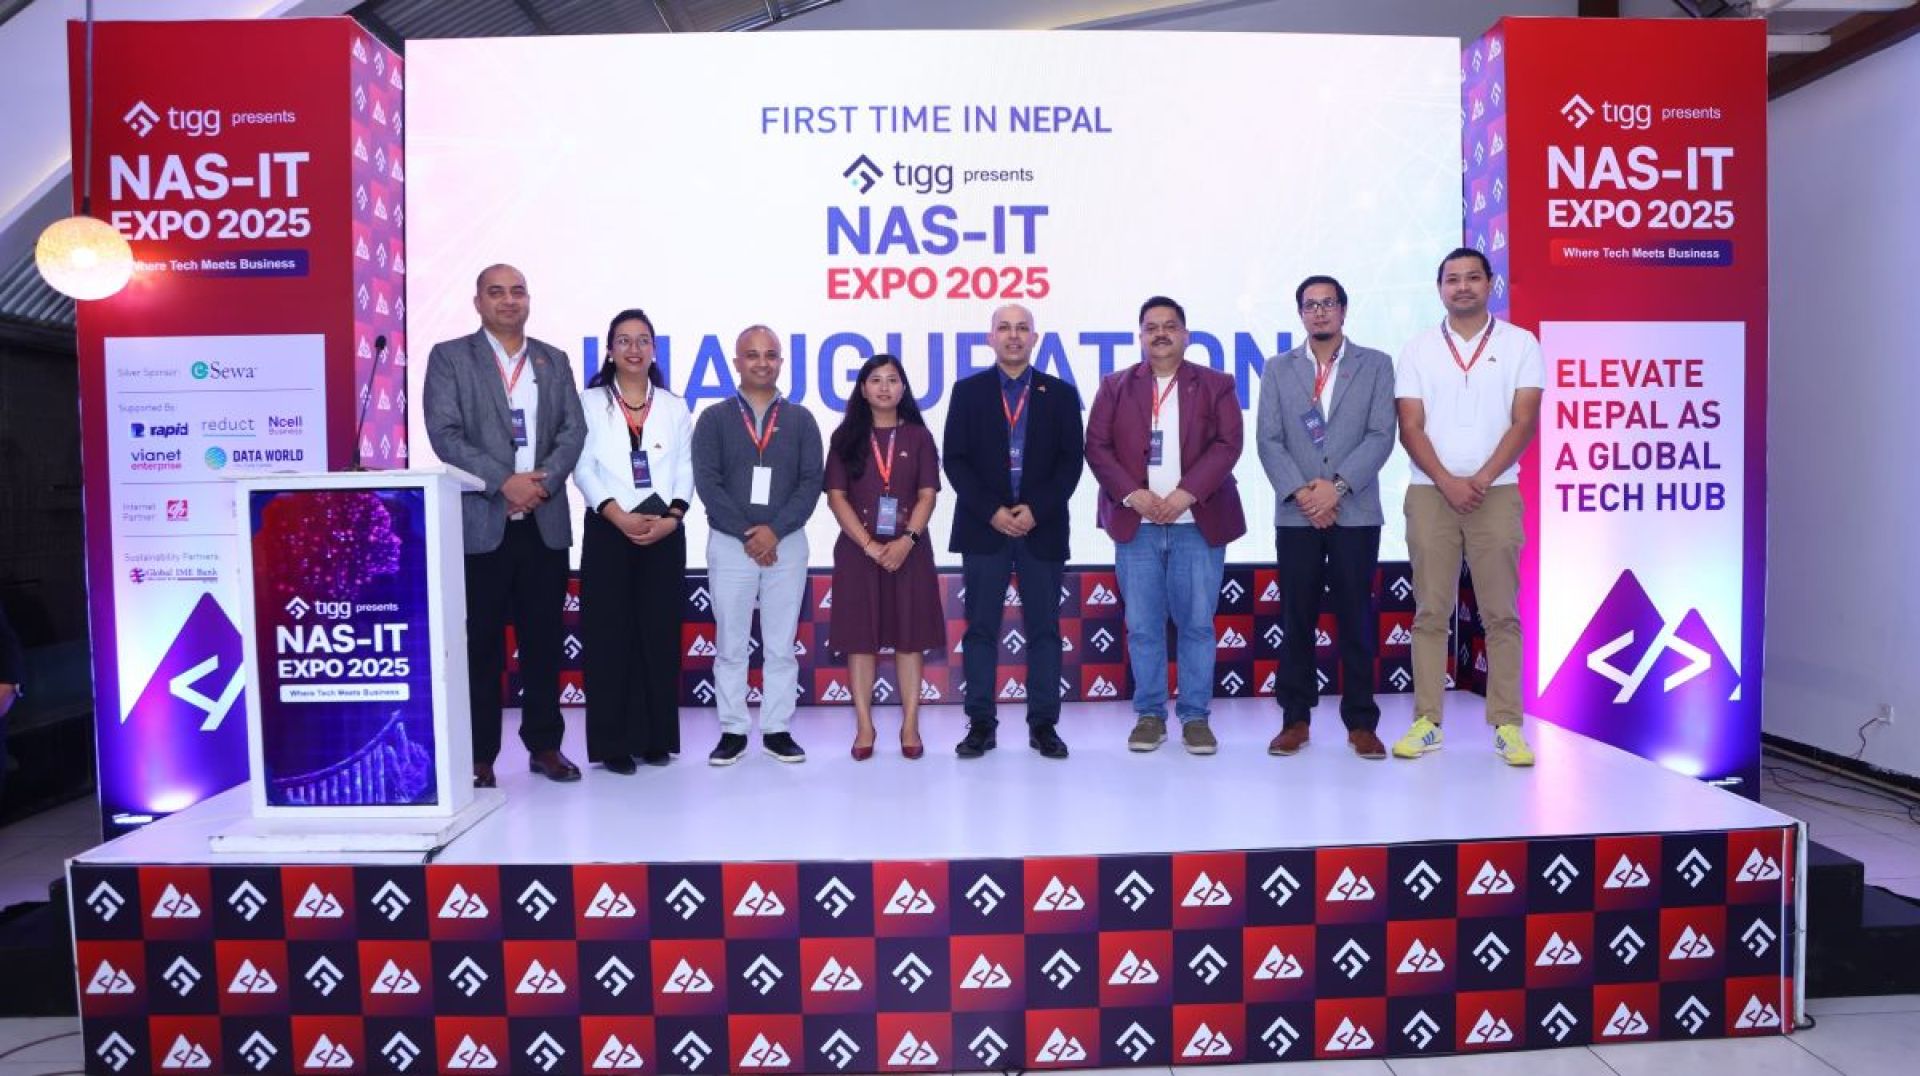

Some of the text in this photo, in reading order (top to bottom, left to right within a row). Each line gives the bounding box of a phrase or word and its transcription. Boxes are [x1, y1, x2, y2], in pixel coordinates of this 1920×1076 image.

[168, 107, 295, 137] tigg presents
[762, 105, 1113, 134] FIRST TIME IN NEPAL
[1602, 100, 1721, 130] tigg presents
[110, 152, 310, 201] NAS-IT
[893, 160, 1034, 194] tigg presents
[1547, 145, 1734, 191] NAS-IT
[111, 208, 311, 241] EXPO 2025
[1548, 200, 1735, 229] EXPO 2025
[827, 205, 1049, 255] NAS-IT
[170, 260, 198, 271] Tech
[201, 259, 237, 270] Meets
[240, 258, 296, 269] Business
[1563, 247, 1720, 259] Where Tech Meets Business
[827, 267, 1050, 300] EXPO 2025
[1557, 359, 1703, 388] ELEVATE
[201, 417, 255, 432] reduct
[268, 416, 303, 428] Ncell
[1557, 400, 1721, 429] NEPAL AS
[150, 422, 189, 438] rapid
[131, 448, 181, 461] vianet
[131, 462, 181, 472] enterprise
[232, 449, 304, 462] DATA WORLD
[1555, 441, 1721, 471] A GLOBAL
[1555, 482, 1726, 512] TECH HUB
[314, 600, 399, 619] tigg presents
[276, 623, 408, 654] NAS-IT
[278, 657, 410, 679] EXPO 2025
